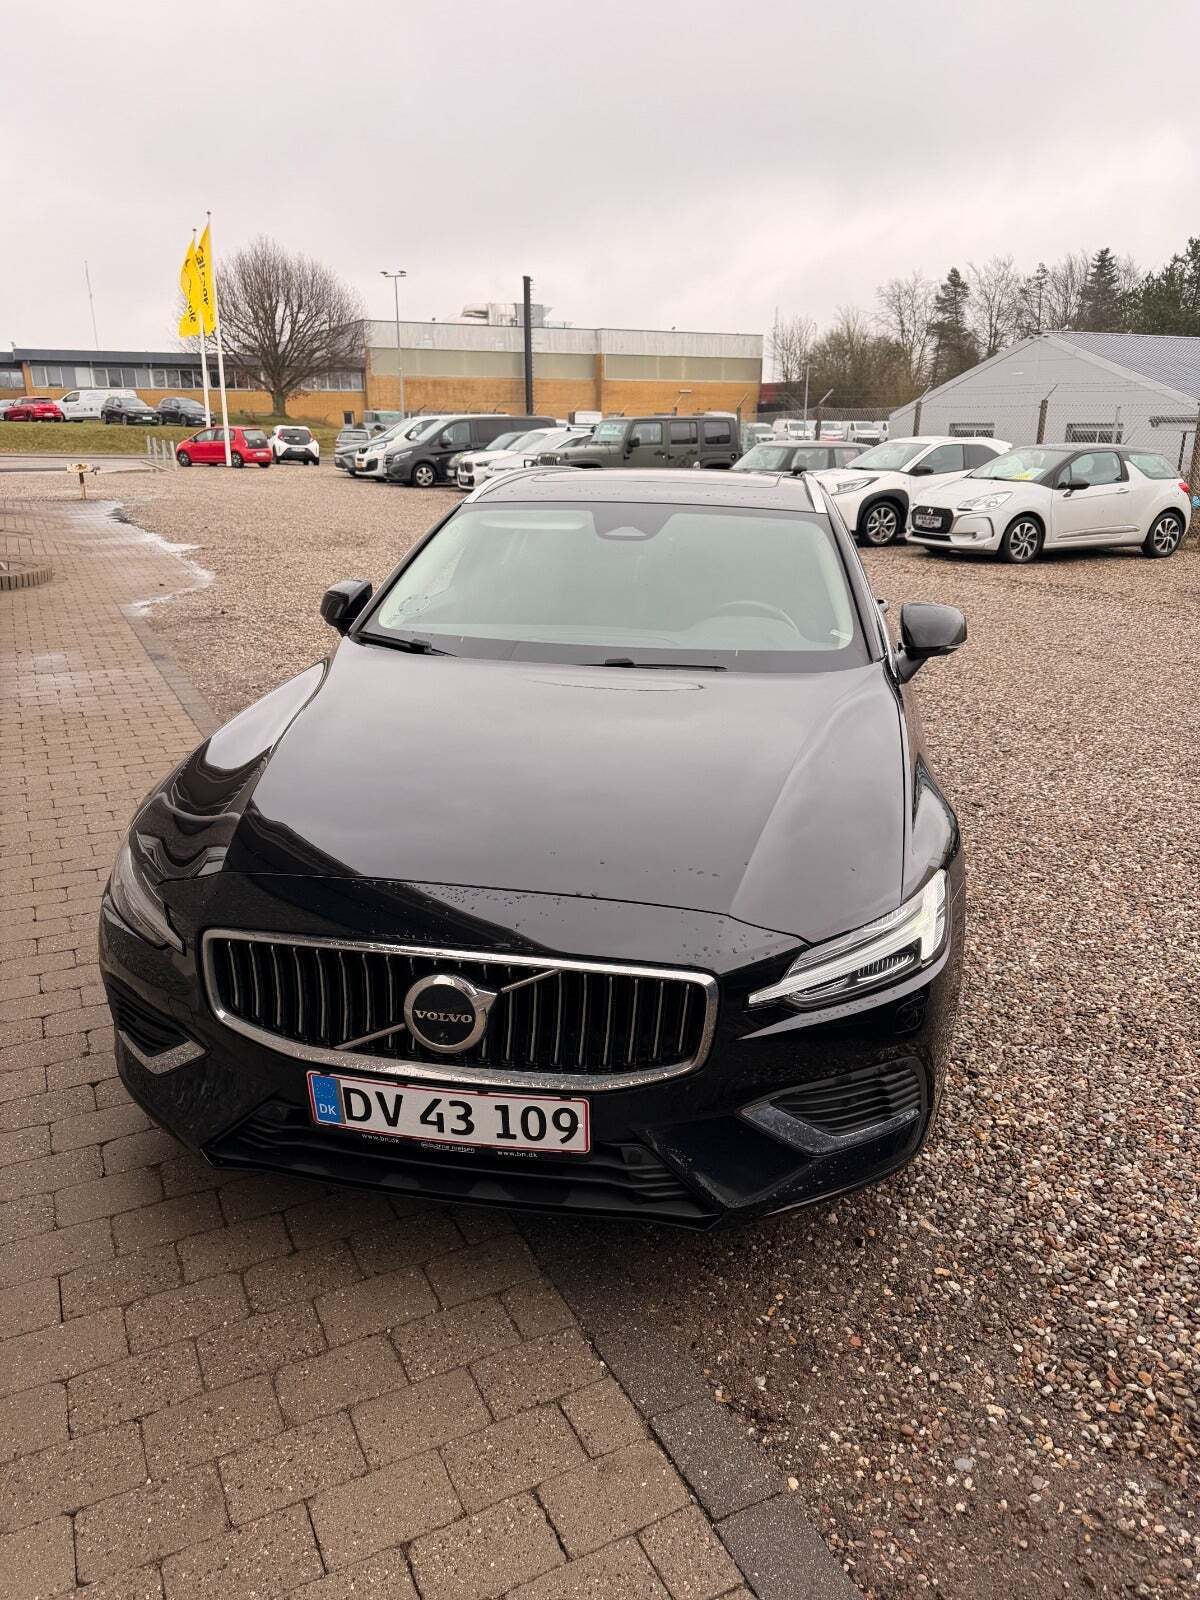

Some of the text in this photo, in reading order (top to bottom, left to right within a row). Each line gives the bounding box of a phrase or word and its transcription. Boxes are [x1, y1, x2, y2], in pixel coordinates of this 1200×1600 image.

[414, 1009, 473, 1023] VOLVO
[319, 1103, 337, 1116] DK
[343, 1086, 579, 1144] DV 43 109
